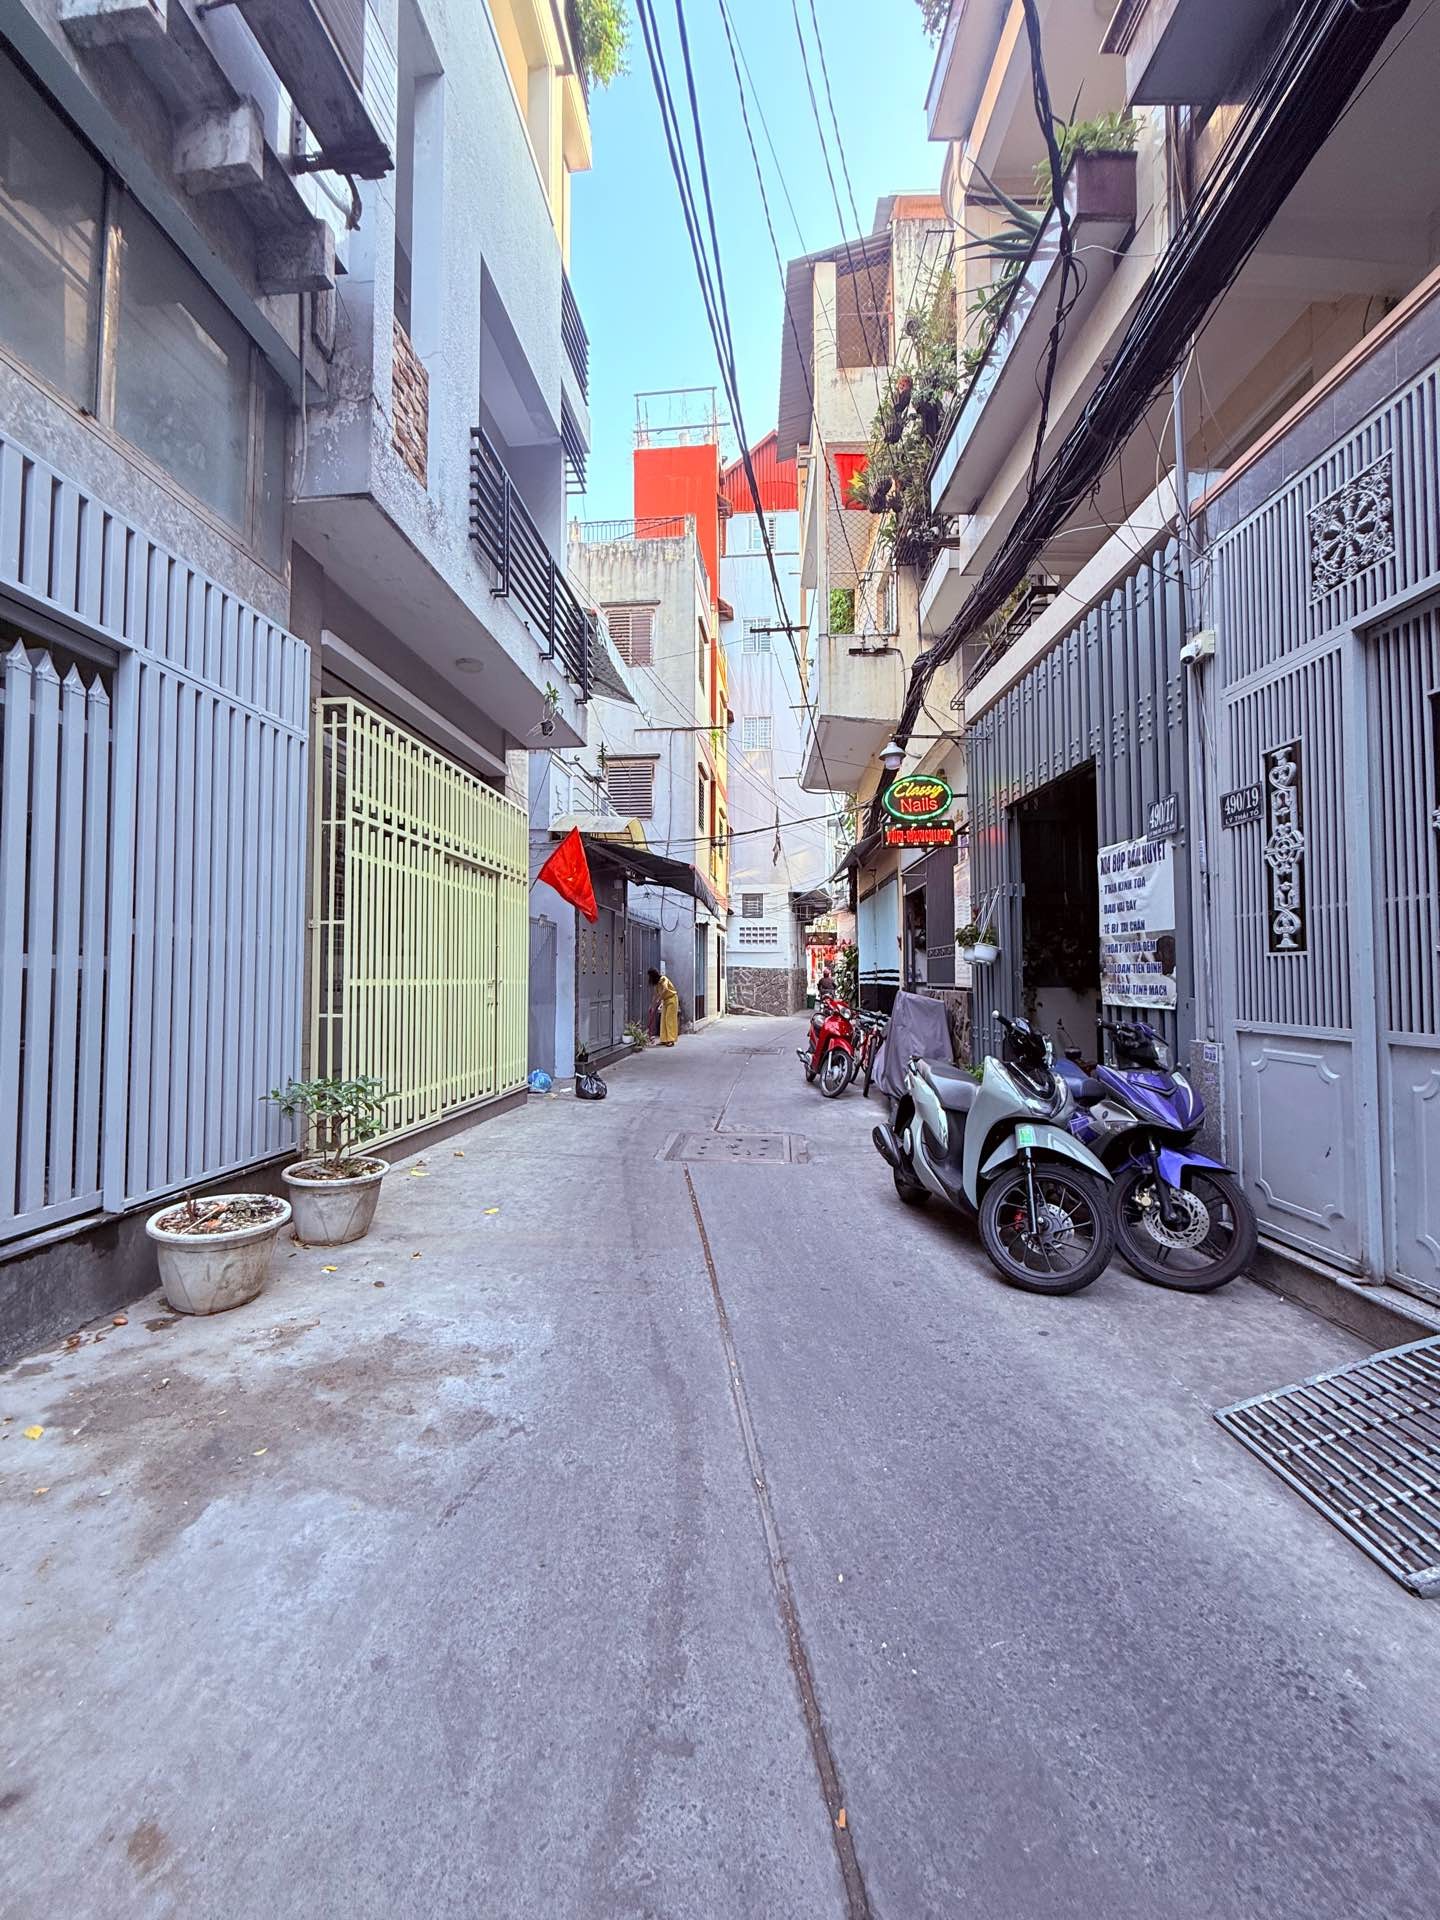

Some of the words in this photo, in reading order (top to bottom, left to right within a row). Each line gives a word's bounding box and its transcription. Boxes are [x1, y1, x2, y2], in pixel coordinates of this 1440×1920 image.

[893, 782, 944, 799] Classy
[1224, 787, 1259, 815] 490/19
[900, 797, 938, 813] Nails
[1149, 797, 1175, 829] 490/17
